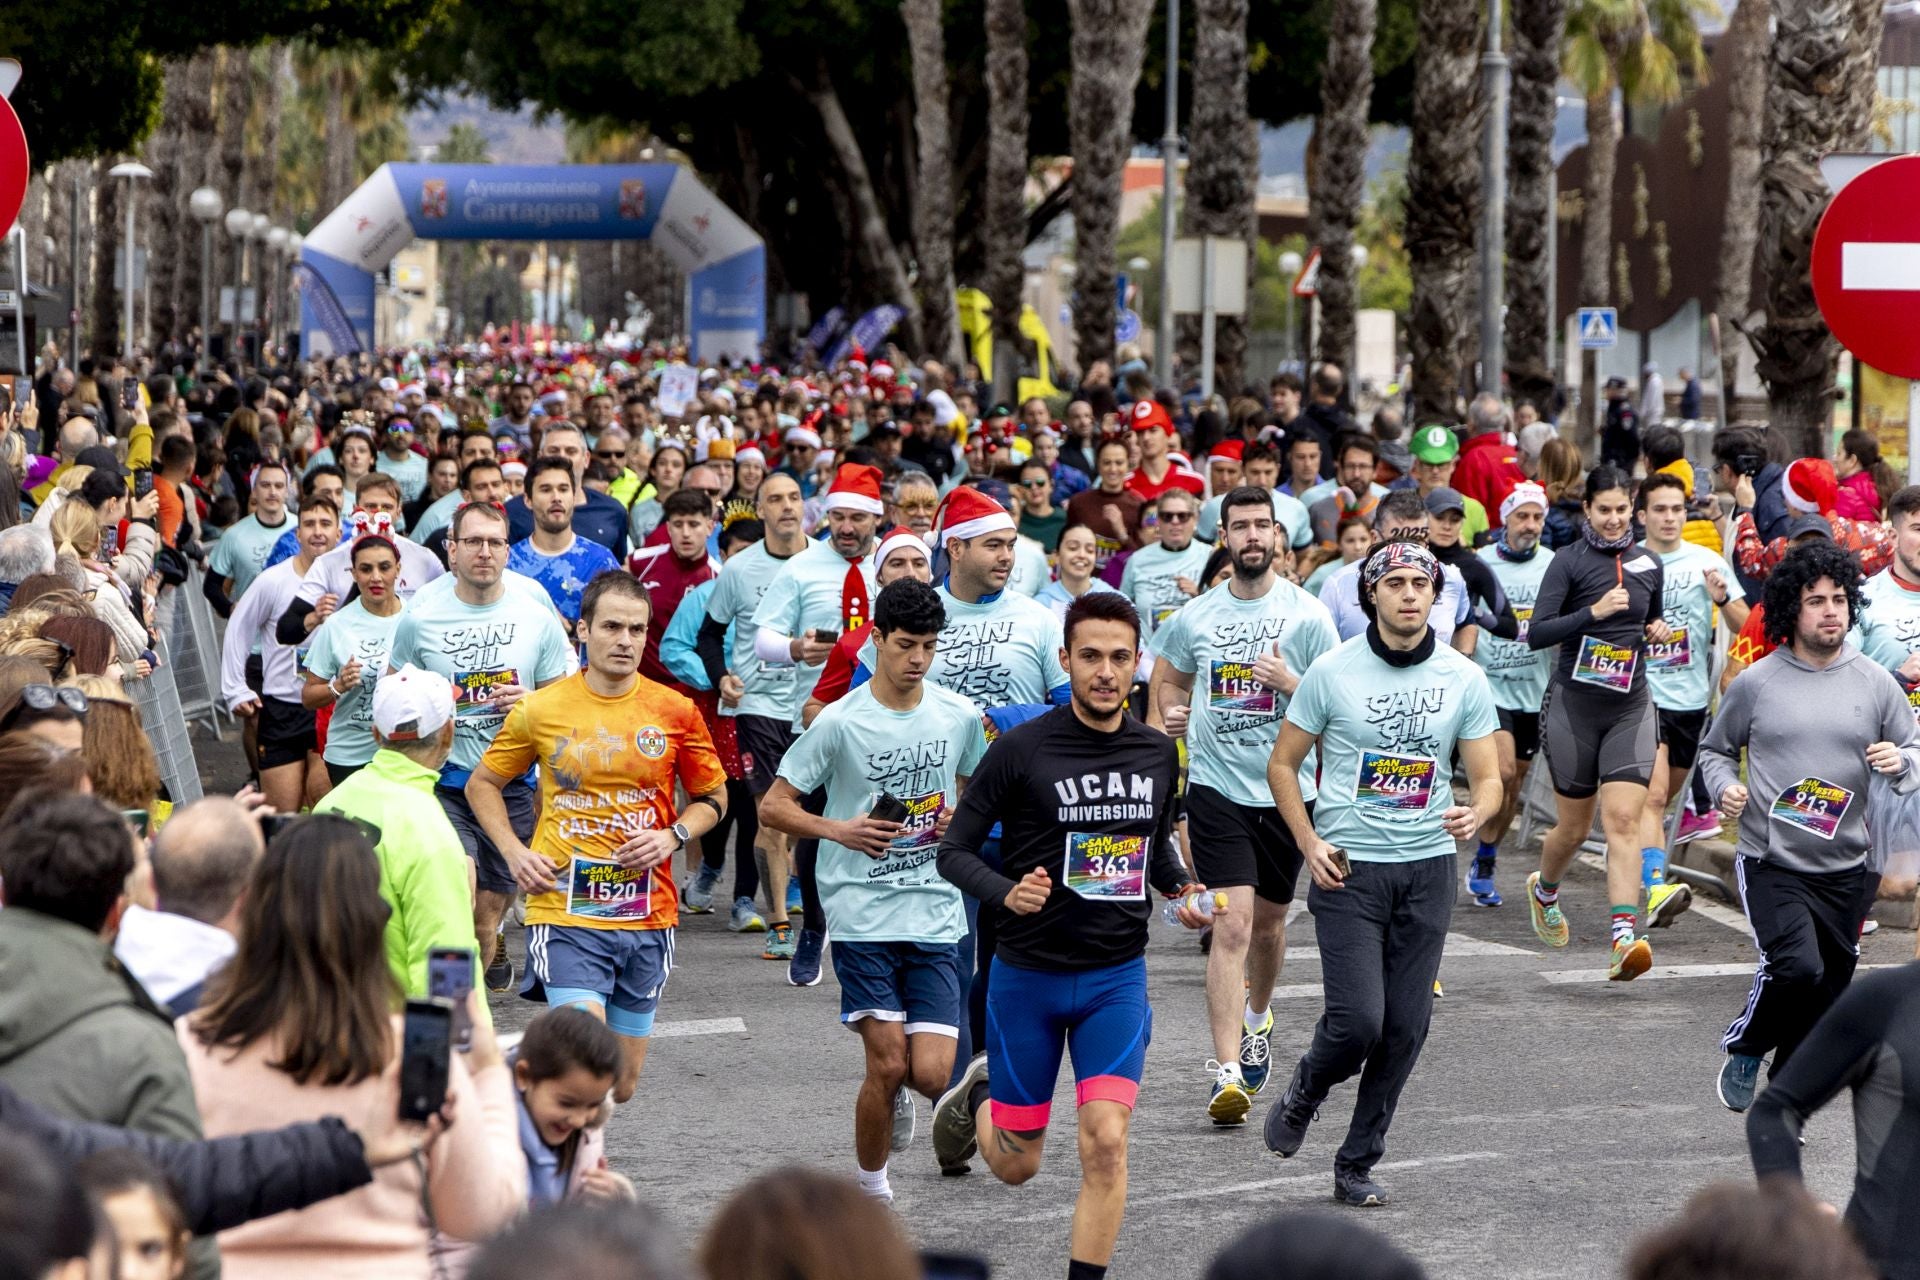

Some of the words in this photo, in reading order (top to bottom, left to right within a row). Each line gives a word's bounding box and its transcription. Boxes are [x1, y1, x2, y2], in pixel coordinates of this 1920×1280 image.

[464, 178, 600, 197] Ayuntamiento
[464, 197, 600, 227] Cartagena
[1391, 526, 1429, 540] 2025
[442, 623, 516, 654] SAN
[936, 621, 1013, 652] SAN
[1211, 618, 1286, 648] SAN
[1647, 642, 1682, 657] 1216
[942, 646, 1001, 677] SIL
[1590, 655, 1625, 675] 1541
[1222, 669, 1252, 679] SILVES
[1220, 678, 1263, 697] 1159
[1365, 688, 1446, 724] SAN
[1377, 716, 1432, 750] SIL
[866, 740, 948, 781] SAN
[1376, 763, 1430, 775] SILVESTRE
[1378, 759, 1400, 767] SAN
[1054, 772, 1153, 805] UCAM
[1371, 772, 1420, 794] 2468
[1058, 804, 1153, 822] UNIVERSIDAD
[1792, 791, 1828, 816] 913
[559, 806, 657, 839] CALVARIO
[896, 812, 935, 833] 455
[1086, 837, 1141, 858] SILVESTRE
[1087, 836, 1112, 848] SAN
[590, 865, 613, 875] SAN
[868, 848, 938, 878] CARTAGEN
[1089, 855, 1129, 877] 363
[587, 880, 637, 901] 1520
